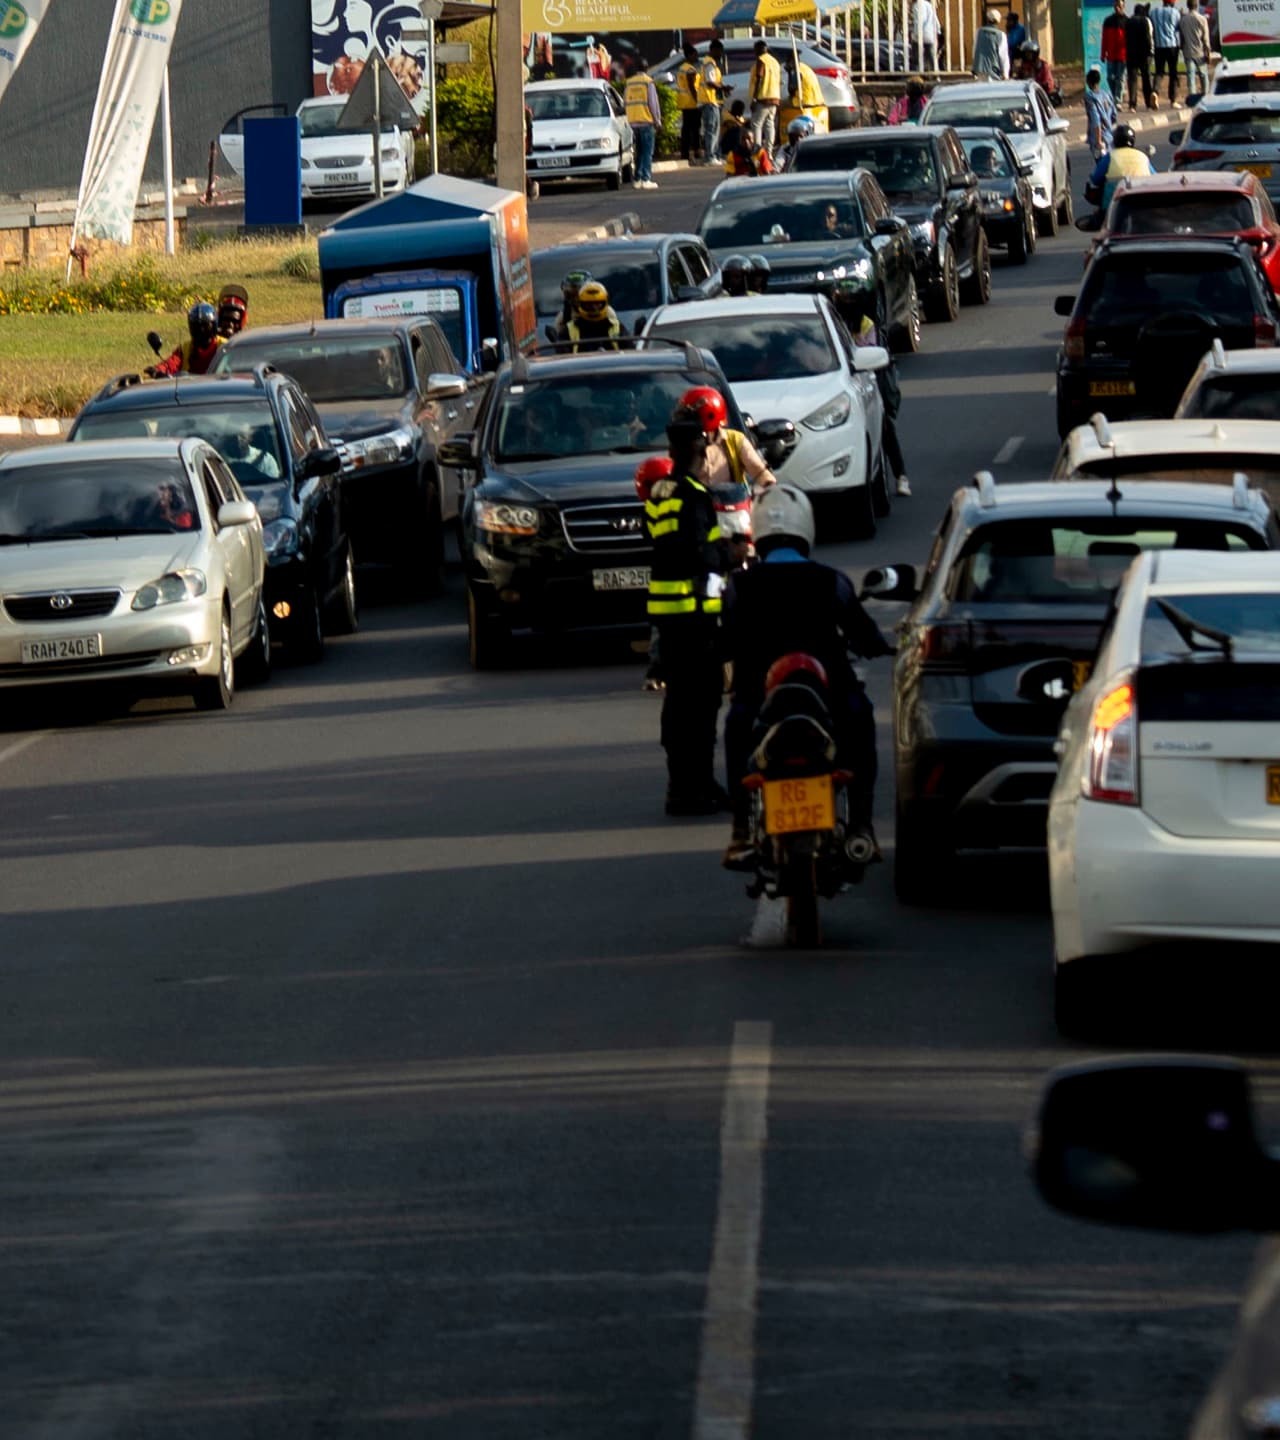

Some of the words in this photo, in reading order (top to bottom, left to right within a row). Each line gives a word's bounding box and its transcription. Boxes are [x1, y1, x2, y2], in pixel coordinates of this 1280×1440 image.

[1235, 2, 1275, 13] SERVICE
[31, 641, 57, 660] RAH
[60, 639, 85, 657] 240
[781, 781, 807, 803] RG
